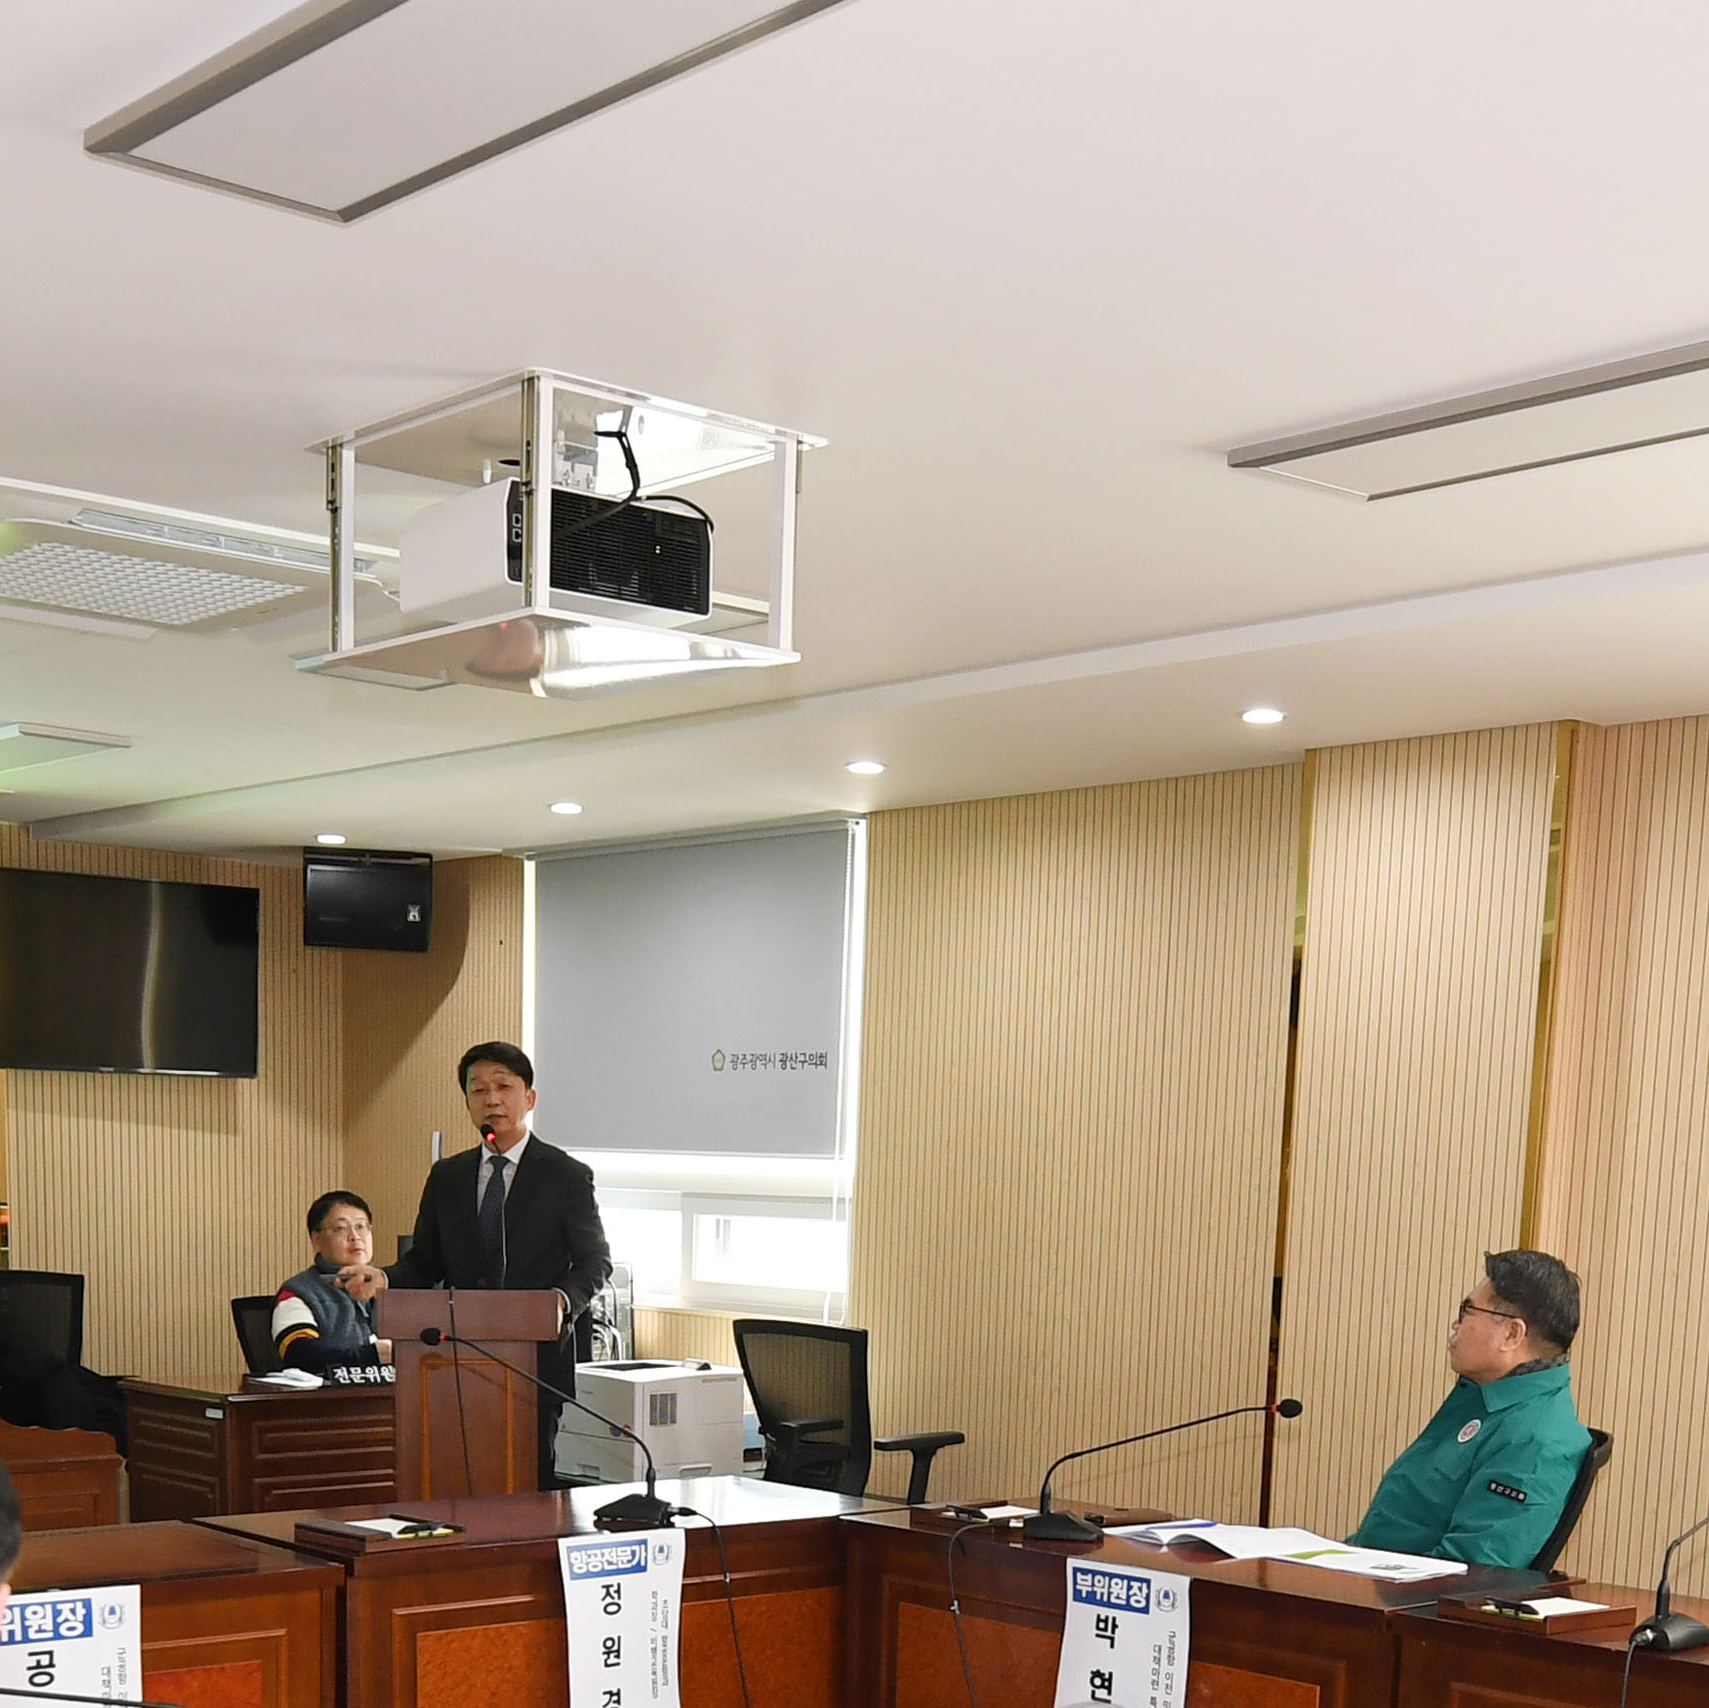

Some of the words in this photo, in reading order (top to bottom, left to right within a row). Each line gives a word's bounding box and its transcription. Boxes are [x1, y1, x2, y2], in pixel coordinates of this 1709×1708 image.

[730, 1052, 776, 1071] 광주광역시
[779, 1051, 828, 1071] 광산구의회
[570, 1544, 646, 1574] 항공전문가
[1076, 1572, 1148, 1608] 부위원장
